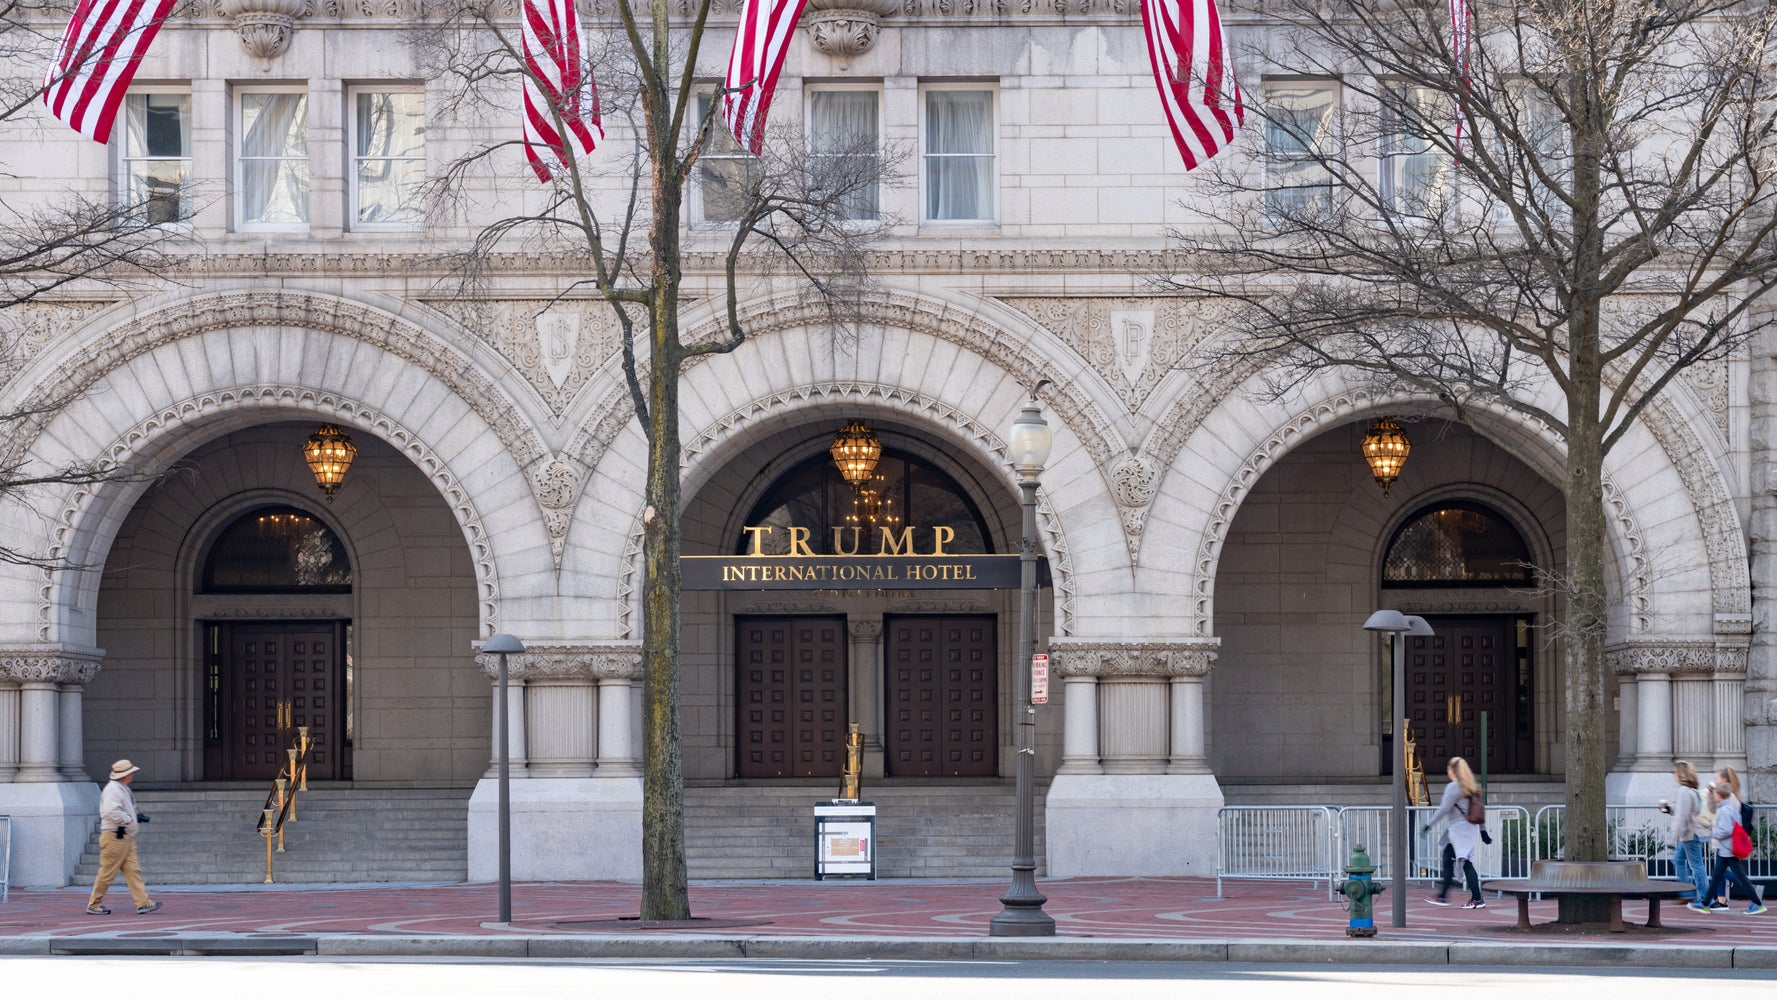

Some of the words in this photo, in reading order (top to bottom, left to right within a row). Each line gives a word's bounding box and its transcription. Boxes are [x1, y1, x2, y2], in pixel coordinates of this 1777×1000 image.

[743, 526, 955, 556] TRUMP
[722, 565, 899, 581] INTERNATIONAL
[905, 565, 977, 580] HOTEL
